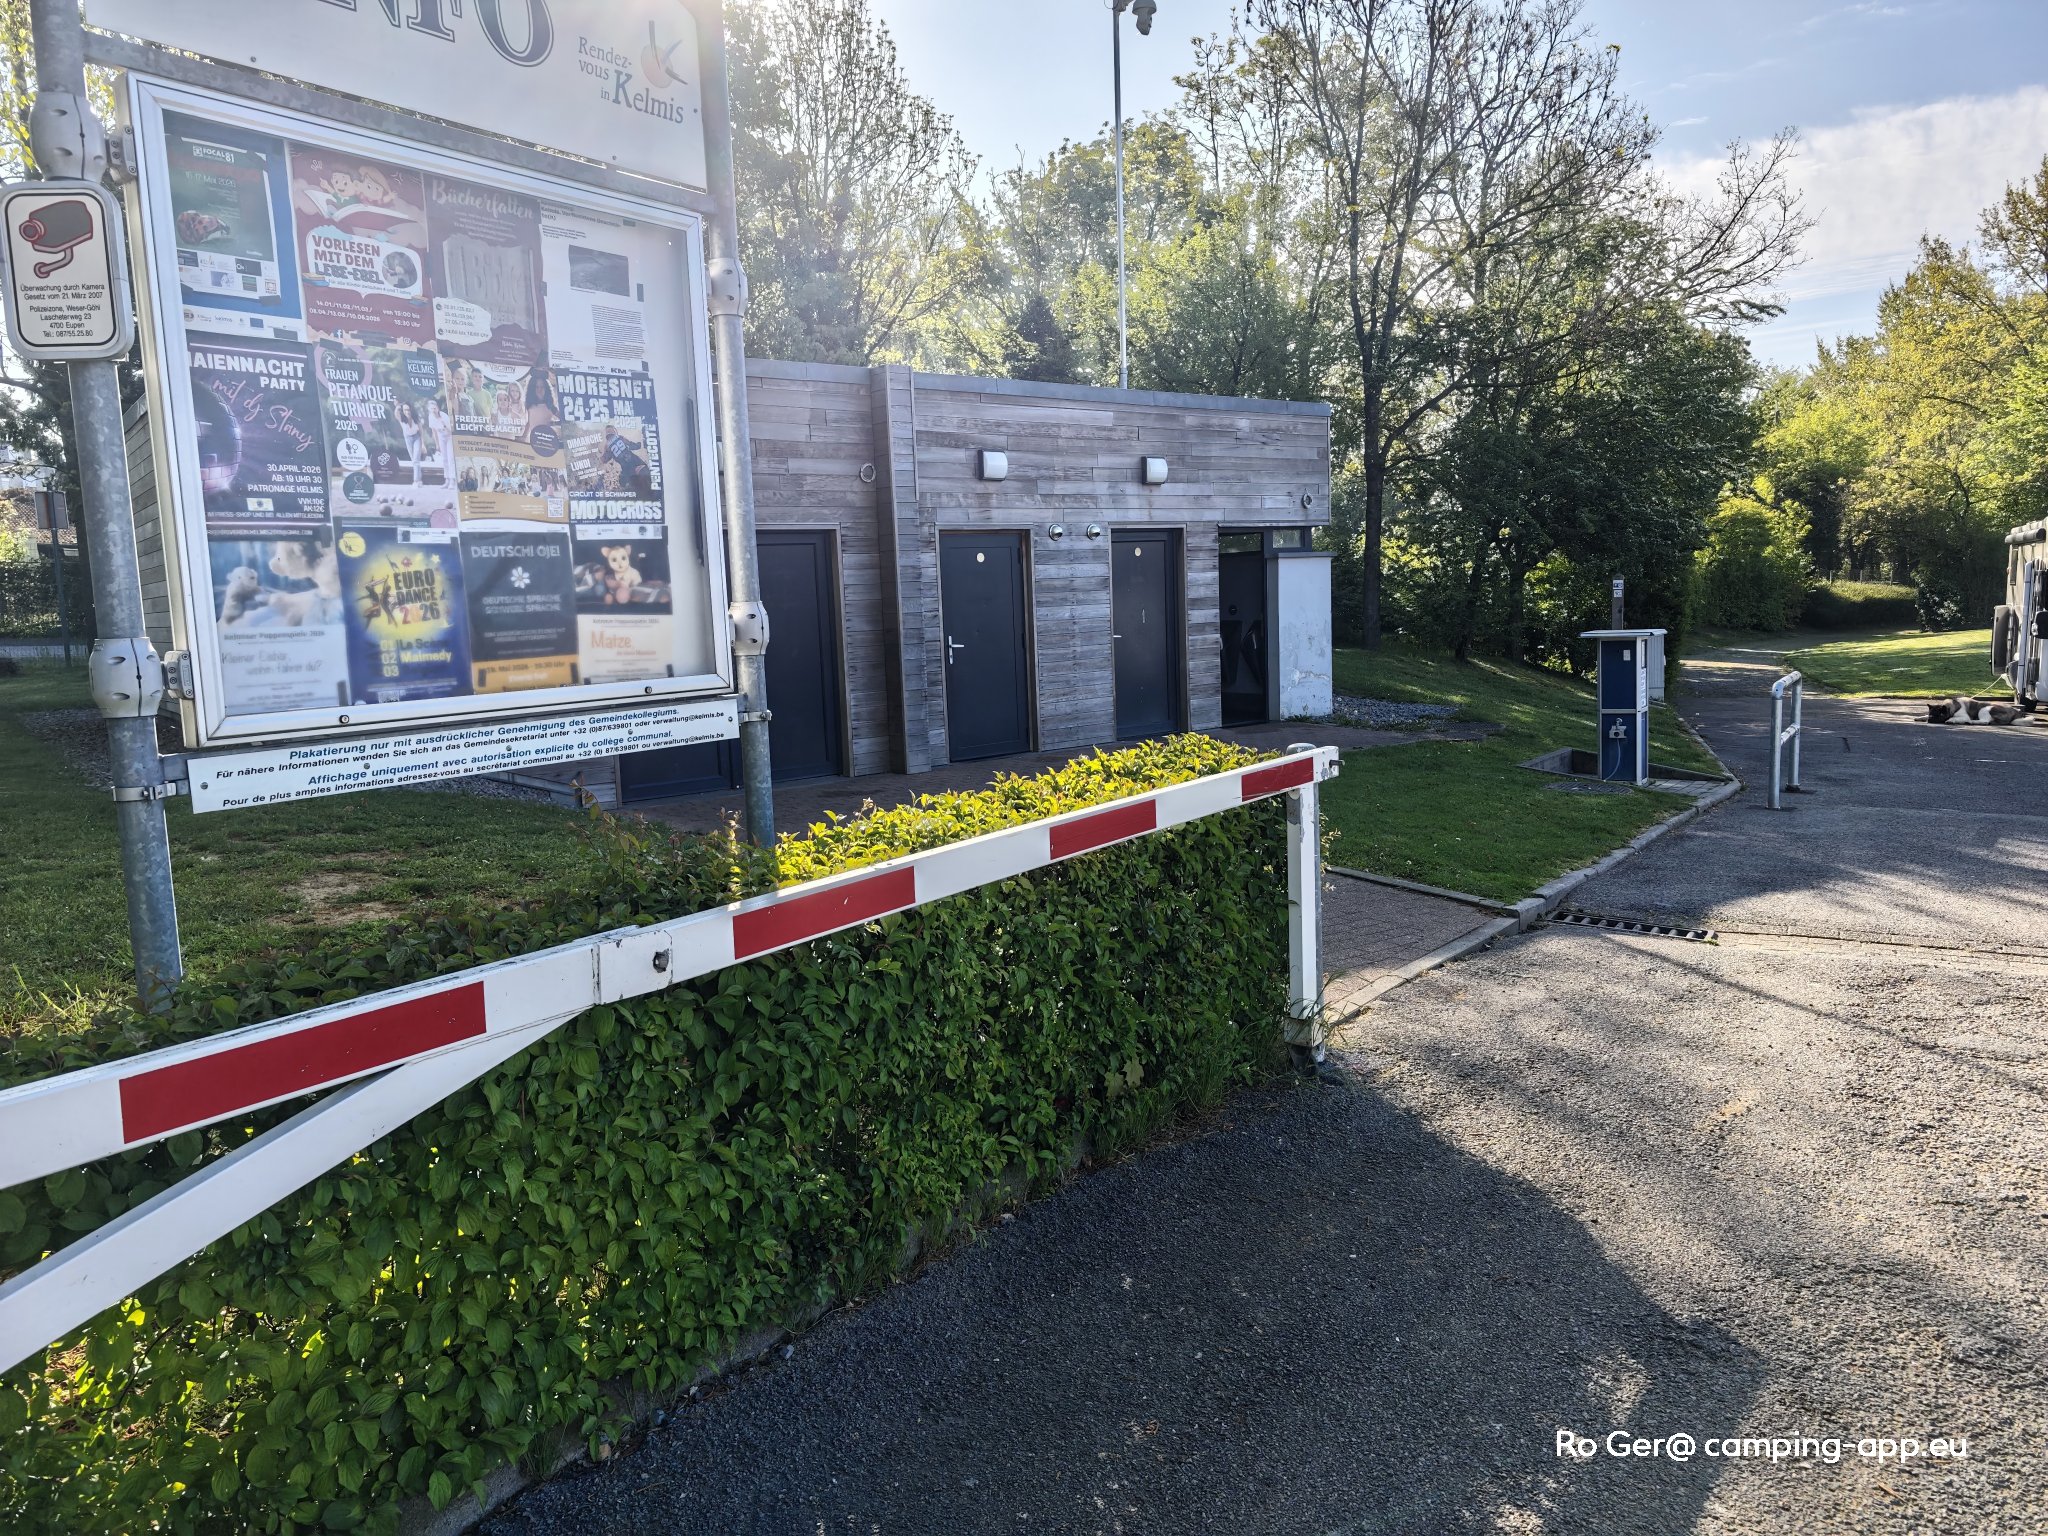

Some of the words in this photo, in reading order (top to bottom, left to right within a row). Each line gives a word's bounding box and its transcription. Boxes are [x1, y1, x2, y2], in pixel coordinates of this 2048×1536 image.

[578, 36, 632, 69] Rendez-
[578, 60, 609, 81] vous
[600, 88, 610, 100] in
[611, 69, 684, 124] Kelmis
[312, 234, 380, 258] VORLESEN
[313, 249, 341, 263] MIT
[345, 253, 375, 269] DEM
[20, 283, 61, 292] Überwachung
[81, 283, 105, 291] Kamera
[188, 351, 305, 378] AIENNACHT
[407, 363, 435, 375] KELMIS
[610, 367, 627, 375] KM
[260, 376, 306, 392] PARTY
[325, 368, 359, 382] FRAUEN
[410, 377, 422, 386] 14.
[422, 378, 437, 388] MAI
[212, 380, 250, 403] mit
[557, 374, 652, 400] MORESNET
[331, 401, 387, 419] TURNIER
[612, 399, 634, 416] MAI
[334, 419, 358, 431] 2026
[455, 415, 491, 424] FREIZEIT
[455, 423, 485, 432] LEICHT
[485, 424, 522, 434] GEMACHT
[566, 432, 603, 450] DIMANCHE
[302, 465, 321, 474] 2026
[570, 458, 591, 472] LUNDI
[272, 474, 285, 482] AB:
[285, 475, 294, 483] 19
[295, 475, 312, 483] UHR
[312, 476, 322, 484] 30
[247, 484, 296, 493] PATRONAGE
[297, 486, 324, 494] KELMIS
[570, 500, 662, 521] MOTOCROSS
[393, 568, 435, 591] EURO
[395, 586, 438, 606] DANCE
[381, 652, 397, 664] 02
[401, 649, 452, 663] Malmedy
[289, 743, 366, 760] Plakatierung
[370, 742, 390, 751] nur
[393, 738, 412, 749] mit
[415, 729, 495, 746] ausdrücklicher
[497, 721, 565, 735] Genehmigung
[569, 715, 586, 727] des
[588, 708, 679, 725] Gemeindekollegiums.
[216, 770, 234, 779] Für
[237, 765, 275, 776] nähere
[278, 757, 349, 771] Informationen
[352, 751, 390, 762] wenden
[392, 748, 407, 757] Sie
[410, 746, 429, 755] sich
[431, 745, 443, 753] an
[445, 742, 461, 751] das
[464, 733, 548, 749] Gemeindesekretariat
[549, 730, 570, 738] unter
[589, 722, 632, 734] (0)87/639801
[634, 720, 651, 728] oder
[652, 711, 725, 726] verwaltung@kelmis.be
[308, 770, 367, 786] Affichage
[371, 761, 439, 777] uniquement
[442, 758, 468, 767] avec
[471, 749, 531, 764] autorisation
[534, 743, 574, 756] explicite
[577, 741, 589, 750] du
[591, 736, 624, 749] collège
[627, 731, 673, 743] communal.
[223, 798, 249, 807] Pour
[252, 795, 266, 803] de
[269, 792, 292, 802] plus
[295, 786, 332, 797] amples
[335, 778, 394, 792] informations
[397, 767, 461, 783] adressez-vous
[476, 760, 521, 772] secrétariat
[523, 753, 564, 766] communal
[578, 750, 592, 758] +32
[594, 748, 603, 756] (0)
[605, 743, 639, 753] 87/639801
[652, 732, 725, 747] verwaltung@kelmis.be
